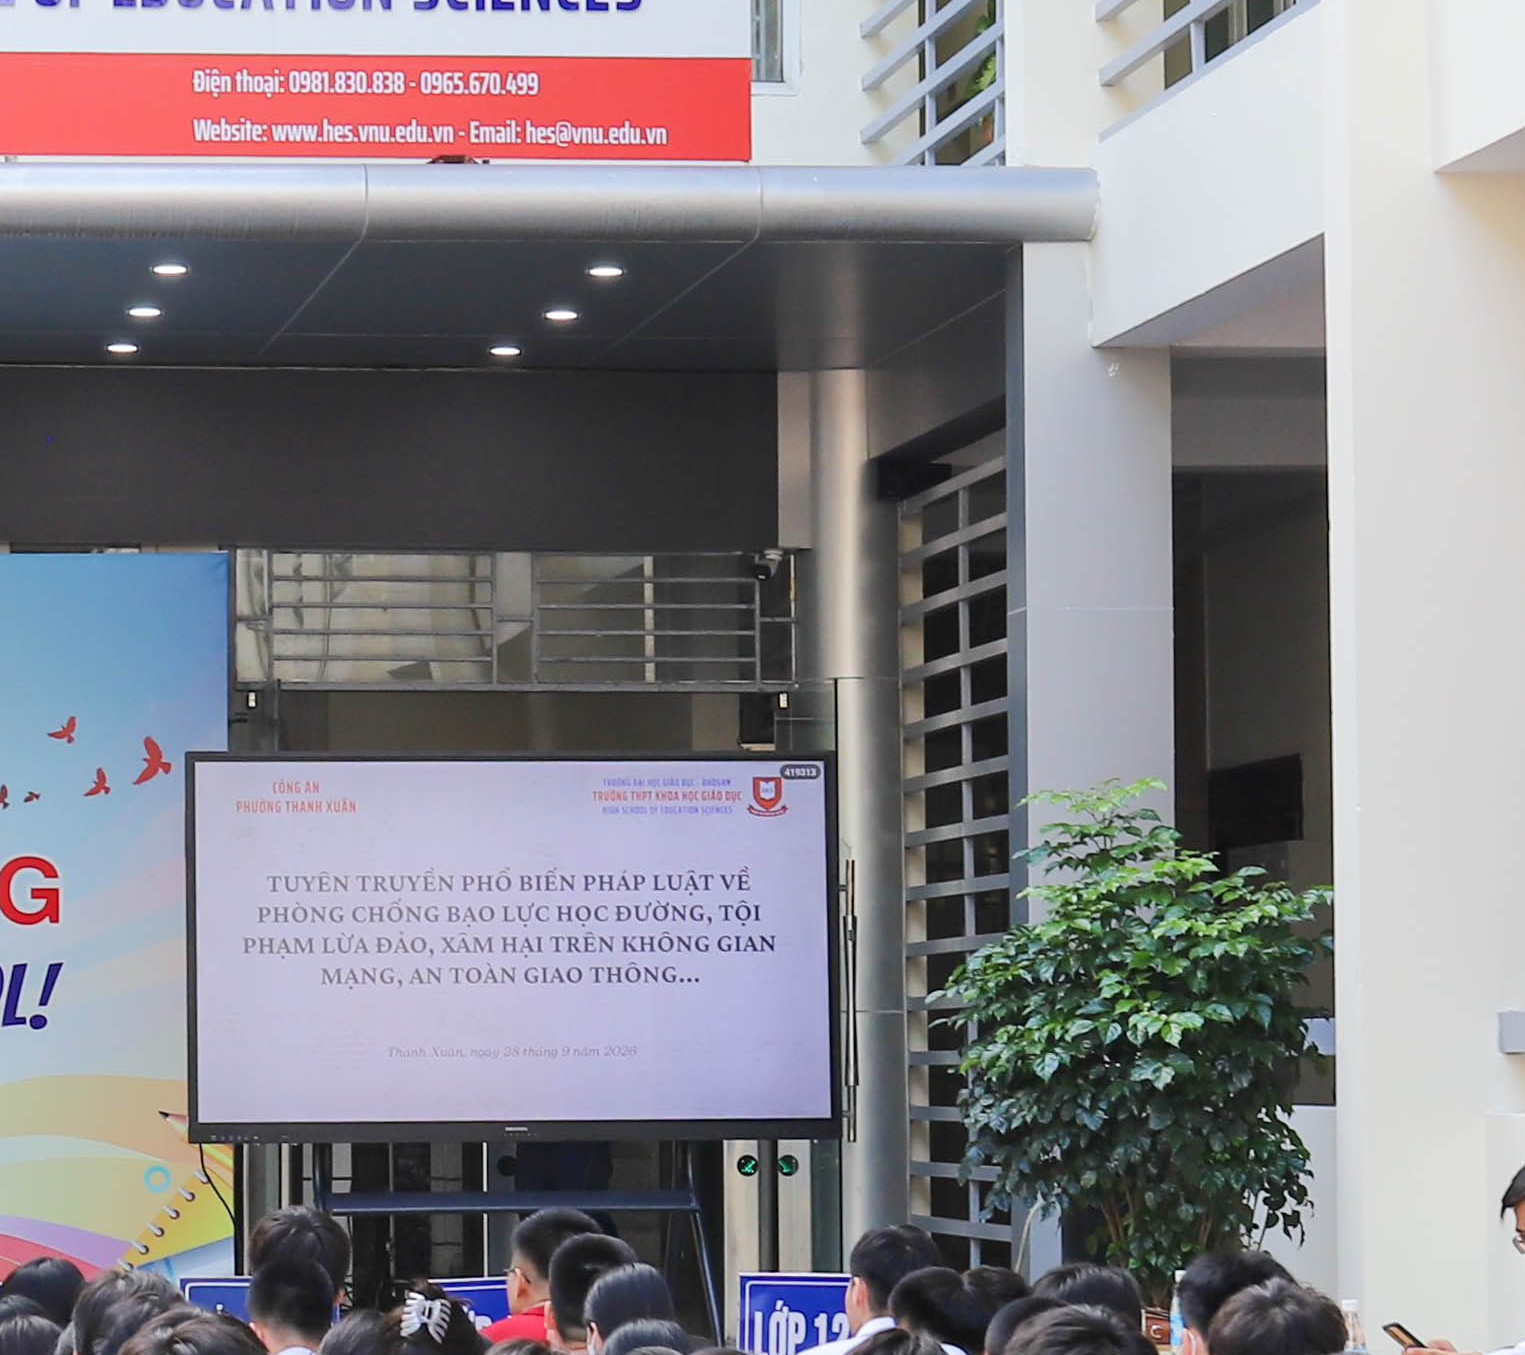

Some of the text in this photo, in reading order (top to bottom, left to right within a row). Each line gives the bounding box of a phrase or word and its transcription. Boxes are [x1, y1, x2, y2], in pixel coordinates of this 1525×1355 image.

[192, 68, 539, 98] Điện thoại: 0981.830.838 0965.670.499
[192, 117, 667, 147] Website: www.hes.vnu.edu.vn Email: hes@vnu.edu.vn
[271, 778, 320, 795] CÔNG AN
[235, 797, 357, 814] PHƯỜNG THANH XUÂN
[266, 865, 751, 897] TUYÊN TRUYỀN PHỔ BIẾN PHÁP LUẬT VỀ
[258, 899, 761, 928] PHÒNG CHỐNG BẠO LỰC HỌC ĐƯỜNG, TỘI
[244, 930, 777, 960] PHẠM LỪA ĐẢO, XÂM HẠI TRÊN KHÔNG GIAN
[321, 961, 700, 990] MẠNG, AN TOÀN GIAO THÔNG...
